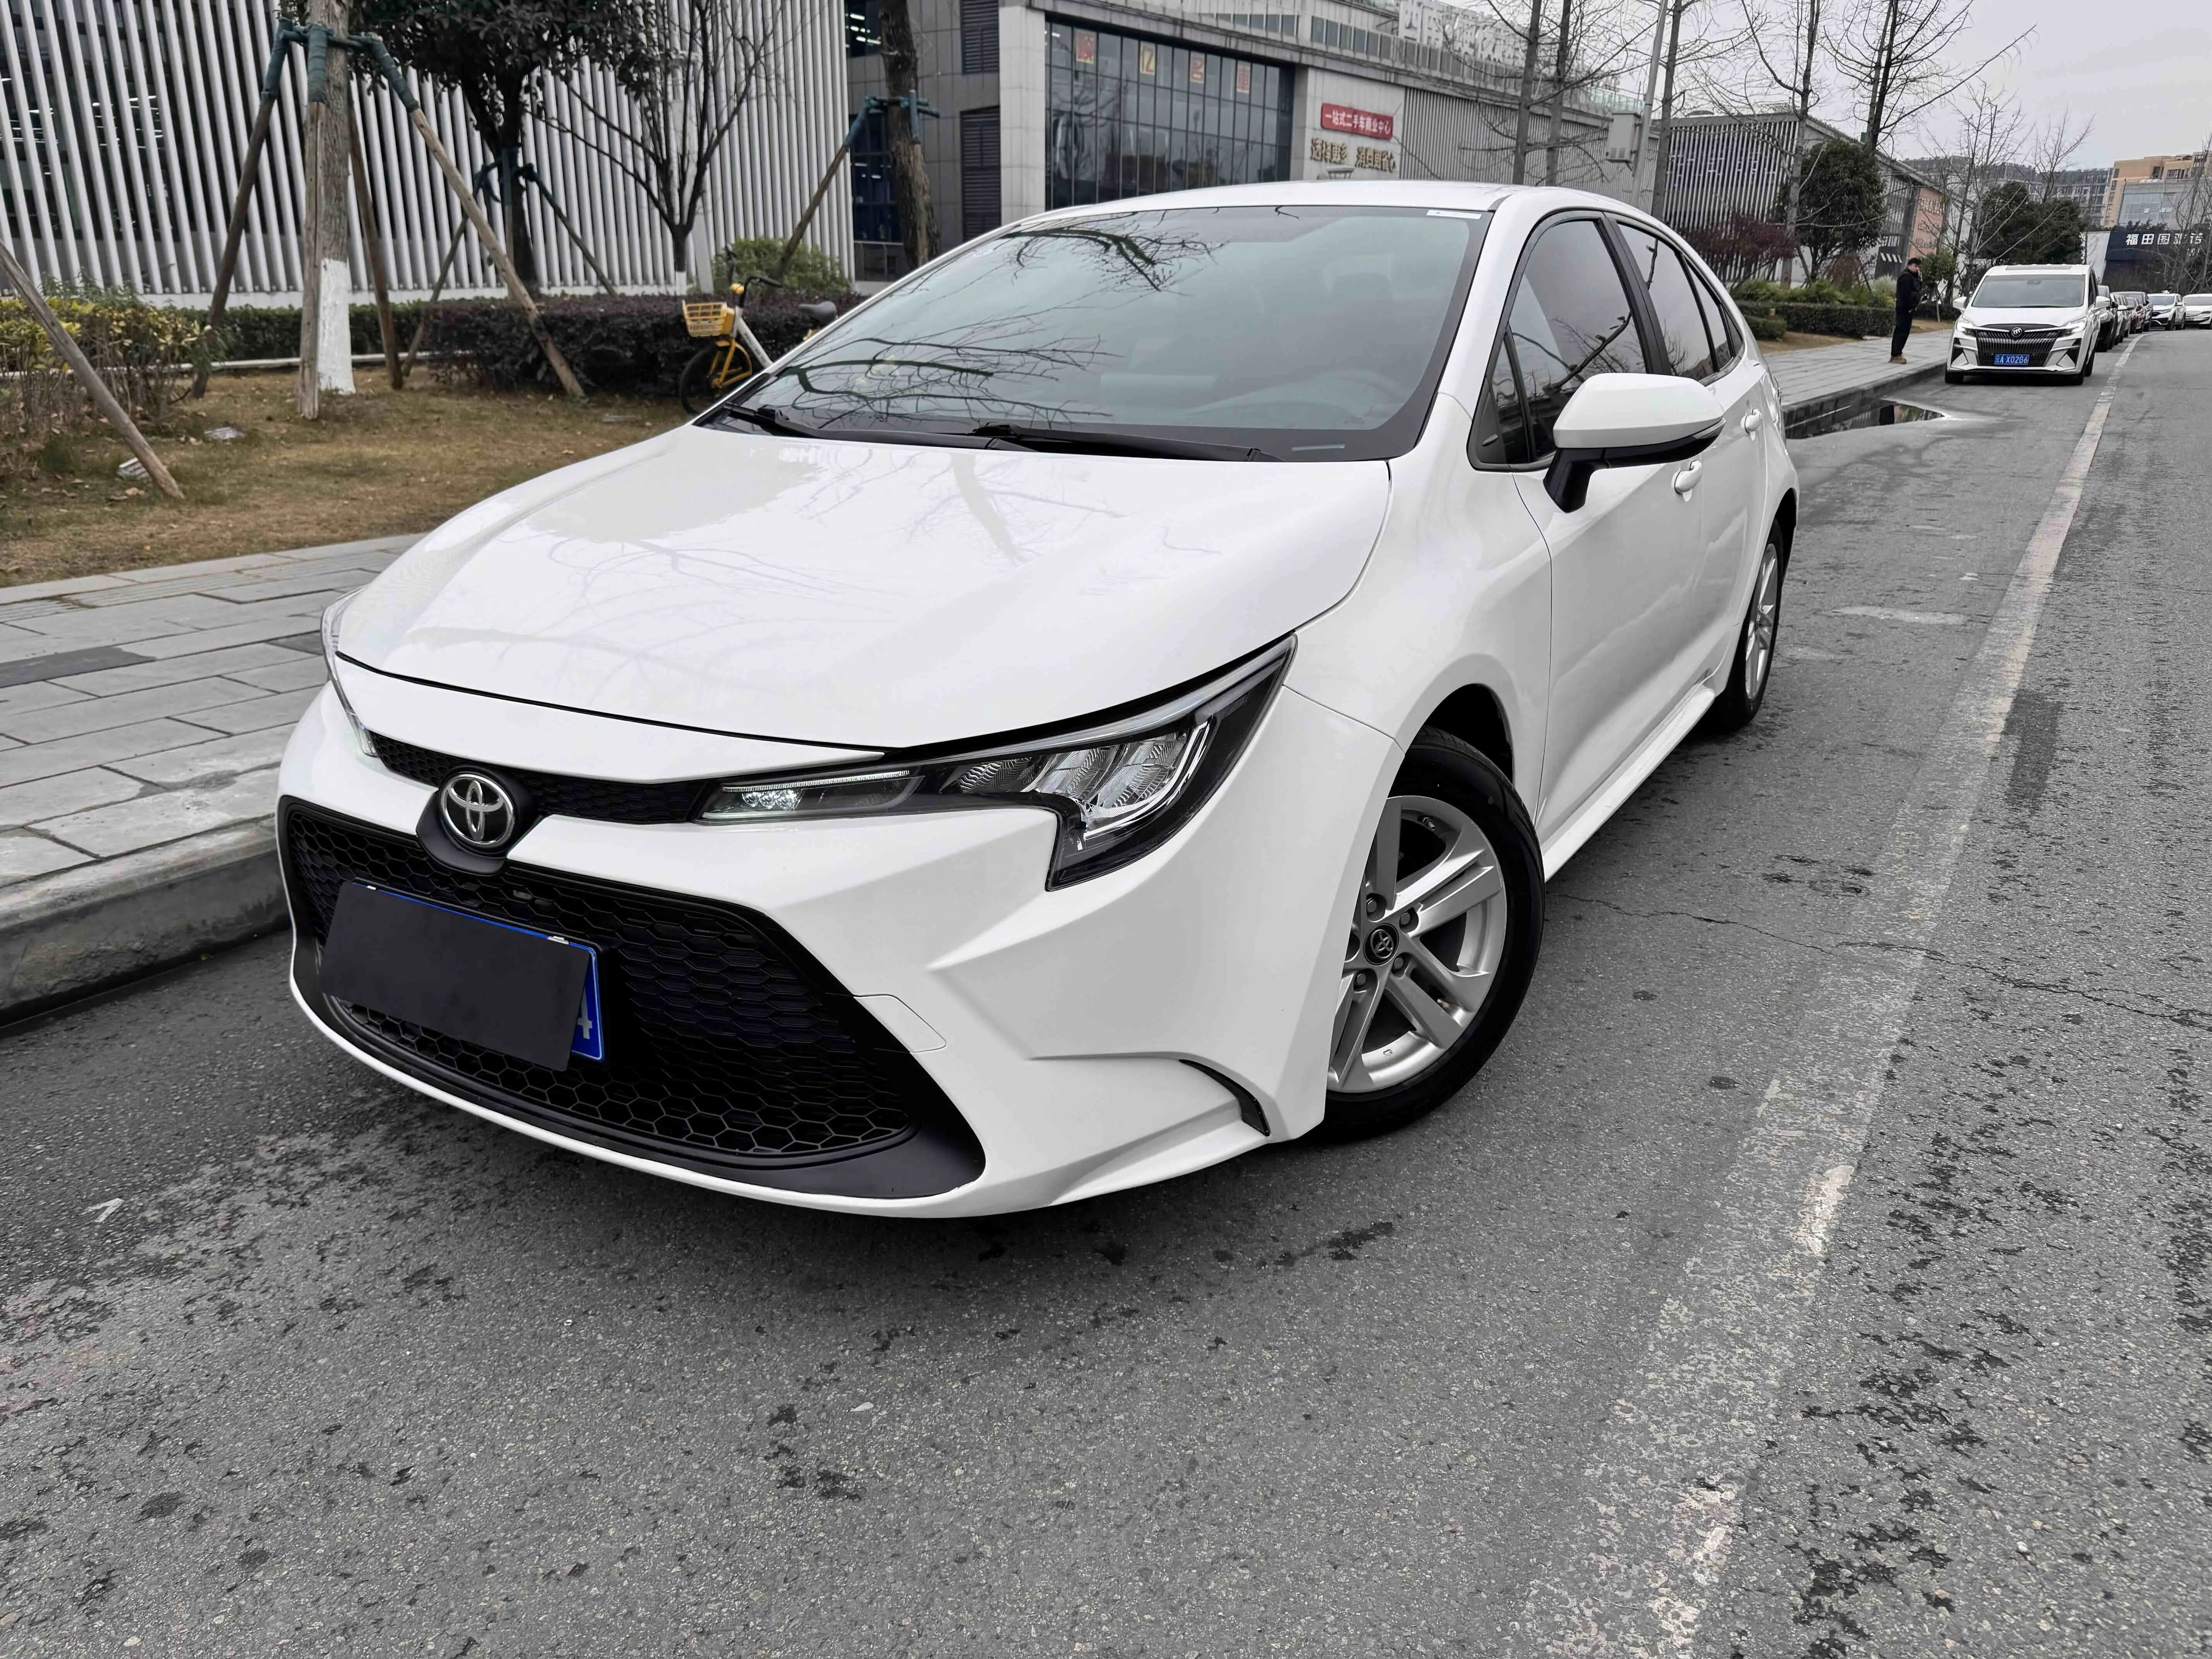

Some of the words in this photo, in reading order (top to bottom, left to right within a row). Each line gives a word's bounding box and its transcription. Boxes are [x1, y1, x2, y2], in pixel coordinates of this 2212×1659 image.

[1325, 110, 1390, 134] 一站式二手车商业中心
